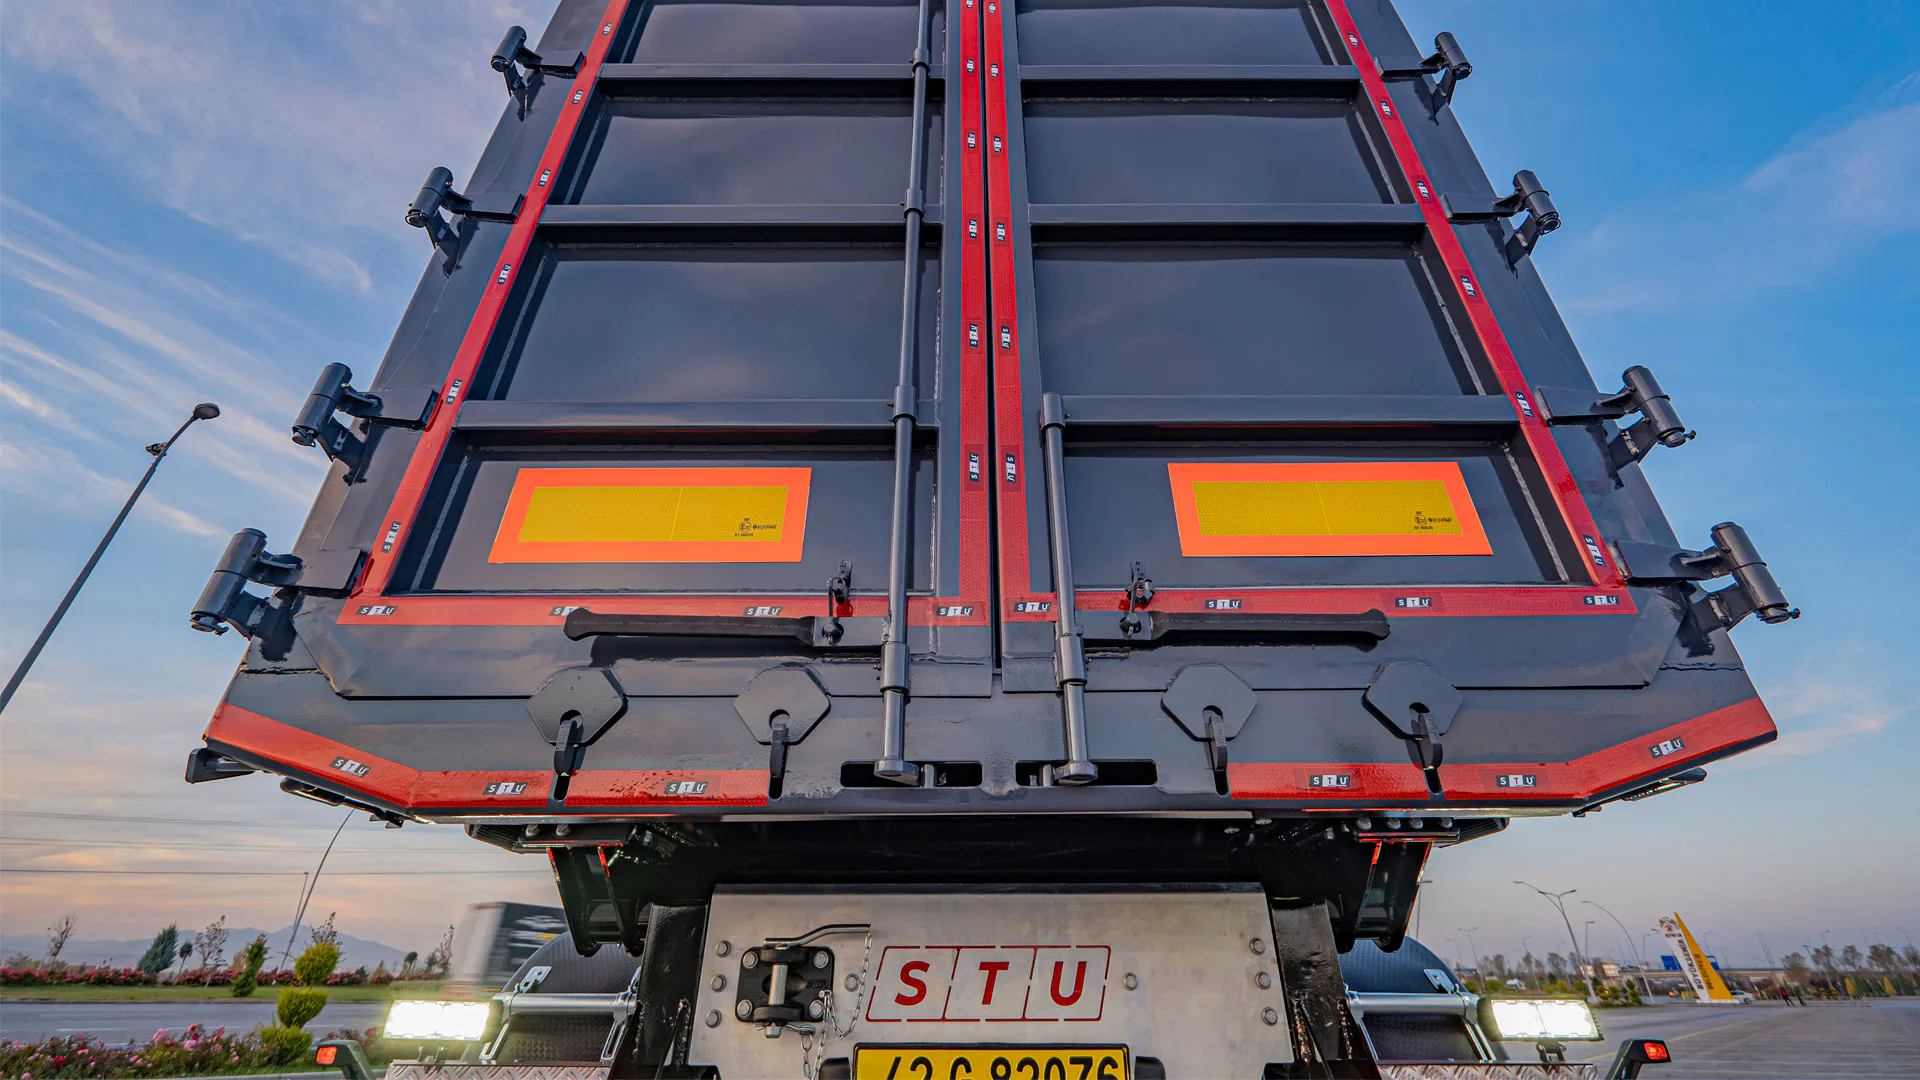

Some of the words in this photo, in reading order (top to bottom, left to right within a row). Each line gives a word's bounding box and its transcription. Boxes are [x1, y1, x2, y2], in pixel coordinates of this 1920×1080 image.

[969, 324, 978, 347] STU
[1001, 326, 1010, 349] STU
[1514, 392, 1534, 418] STU
[969, 453, 979, 482] STU
[1005, 454, 1015, 483] STU
[382, 522, 401, 552] STU
[1583, 535, 1606, 568] STU
[1016, 602, 1051, 612] STU
[1206, 599, 1241, 610] STU
[1396, 597, 1431, 608] STU
[1586, 595, 1620, 606] STU
[359, 606, 396, 616] STU
[746, 606, 780, 616] STU
[938, 606, 973, 617] STU
[1651, 737, 1684, 757] STU
[333, 757, 370, 777] STU
[1312, 774, 1349, 787] STU
[1499, 774, 1535, 788] STU
[486, 782, 526, 795] STU
[667, 782, 707, 795] STU
[894, 960, 1087, 1006] STU
